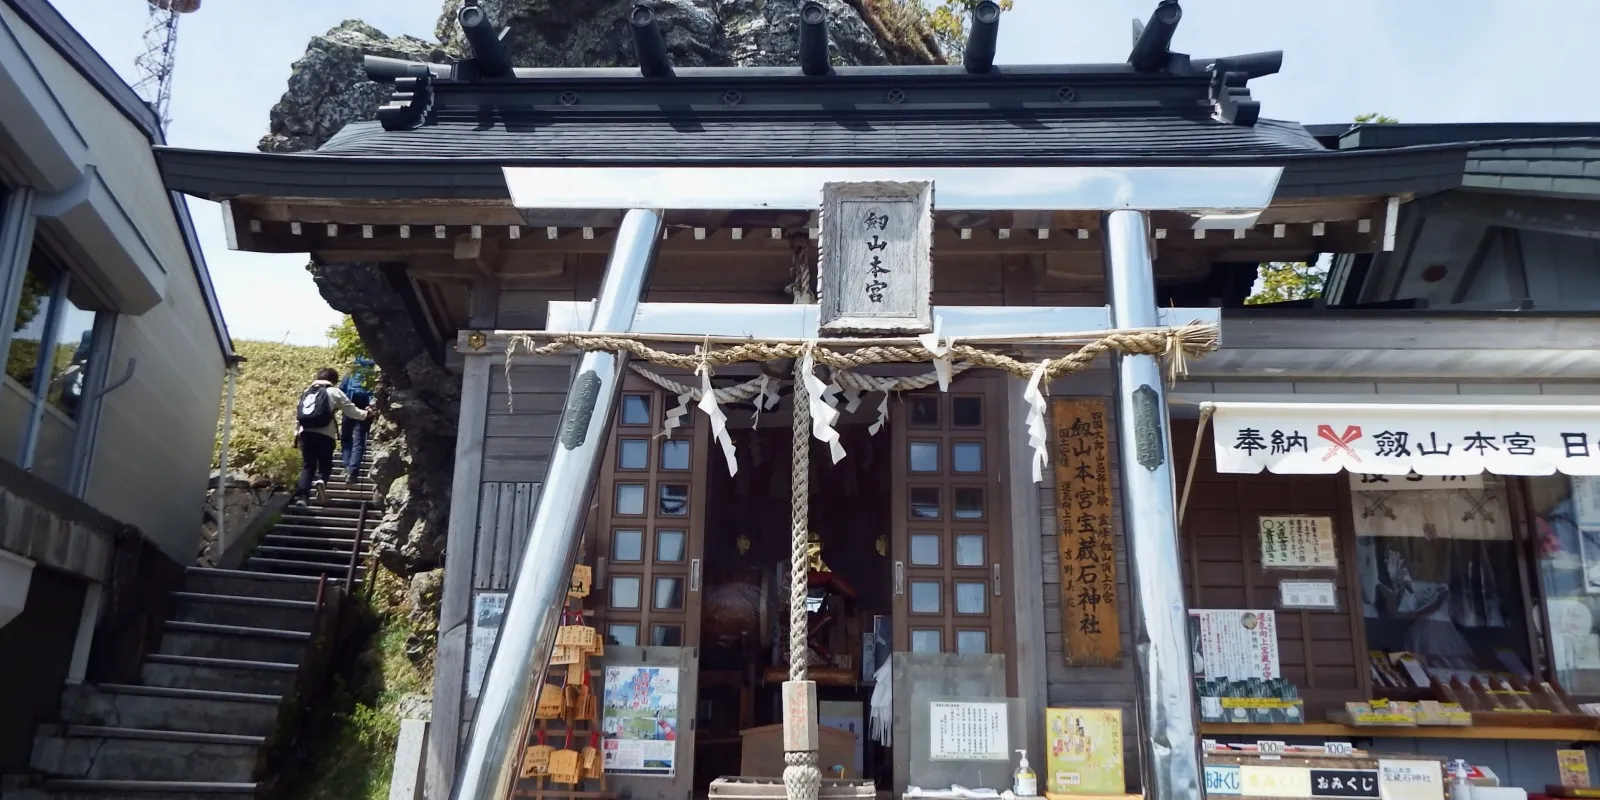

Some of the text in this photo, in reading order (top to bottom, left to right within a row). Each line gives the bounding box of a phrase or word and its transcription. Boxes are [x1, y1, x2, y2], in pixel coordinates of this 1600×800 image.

[1233, 428, 1308, 456] 奉納
[1560, 432, 1600, 458] 日
[1259, 742, 1284, 753] 100円
[1326, 743, 1351, 754] 100円
[1205, 771, 1240, 789] おみくじ
[1317, 775, 1375, 791] おみくじ
